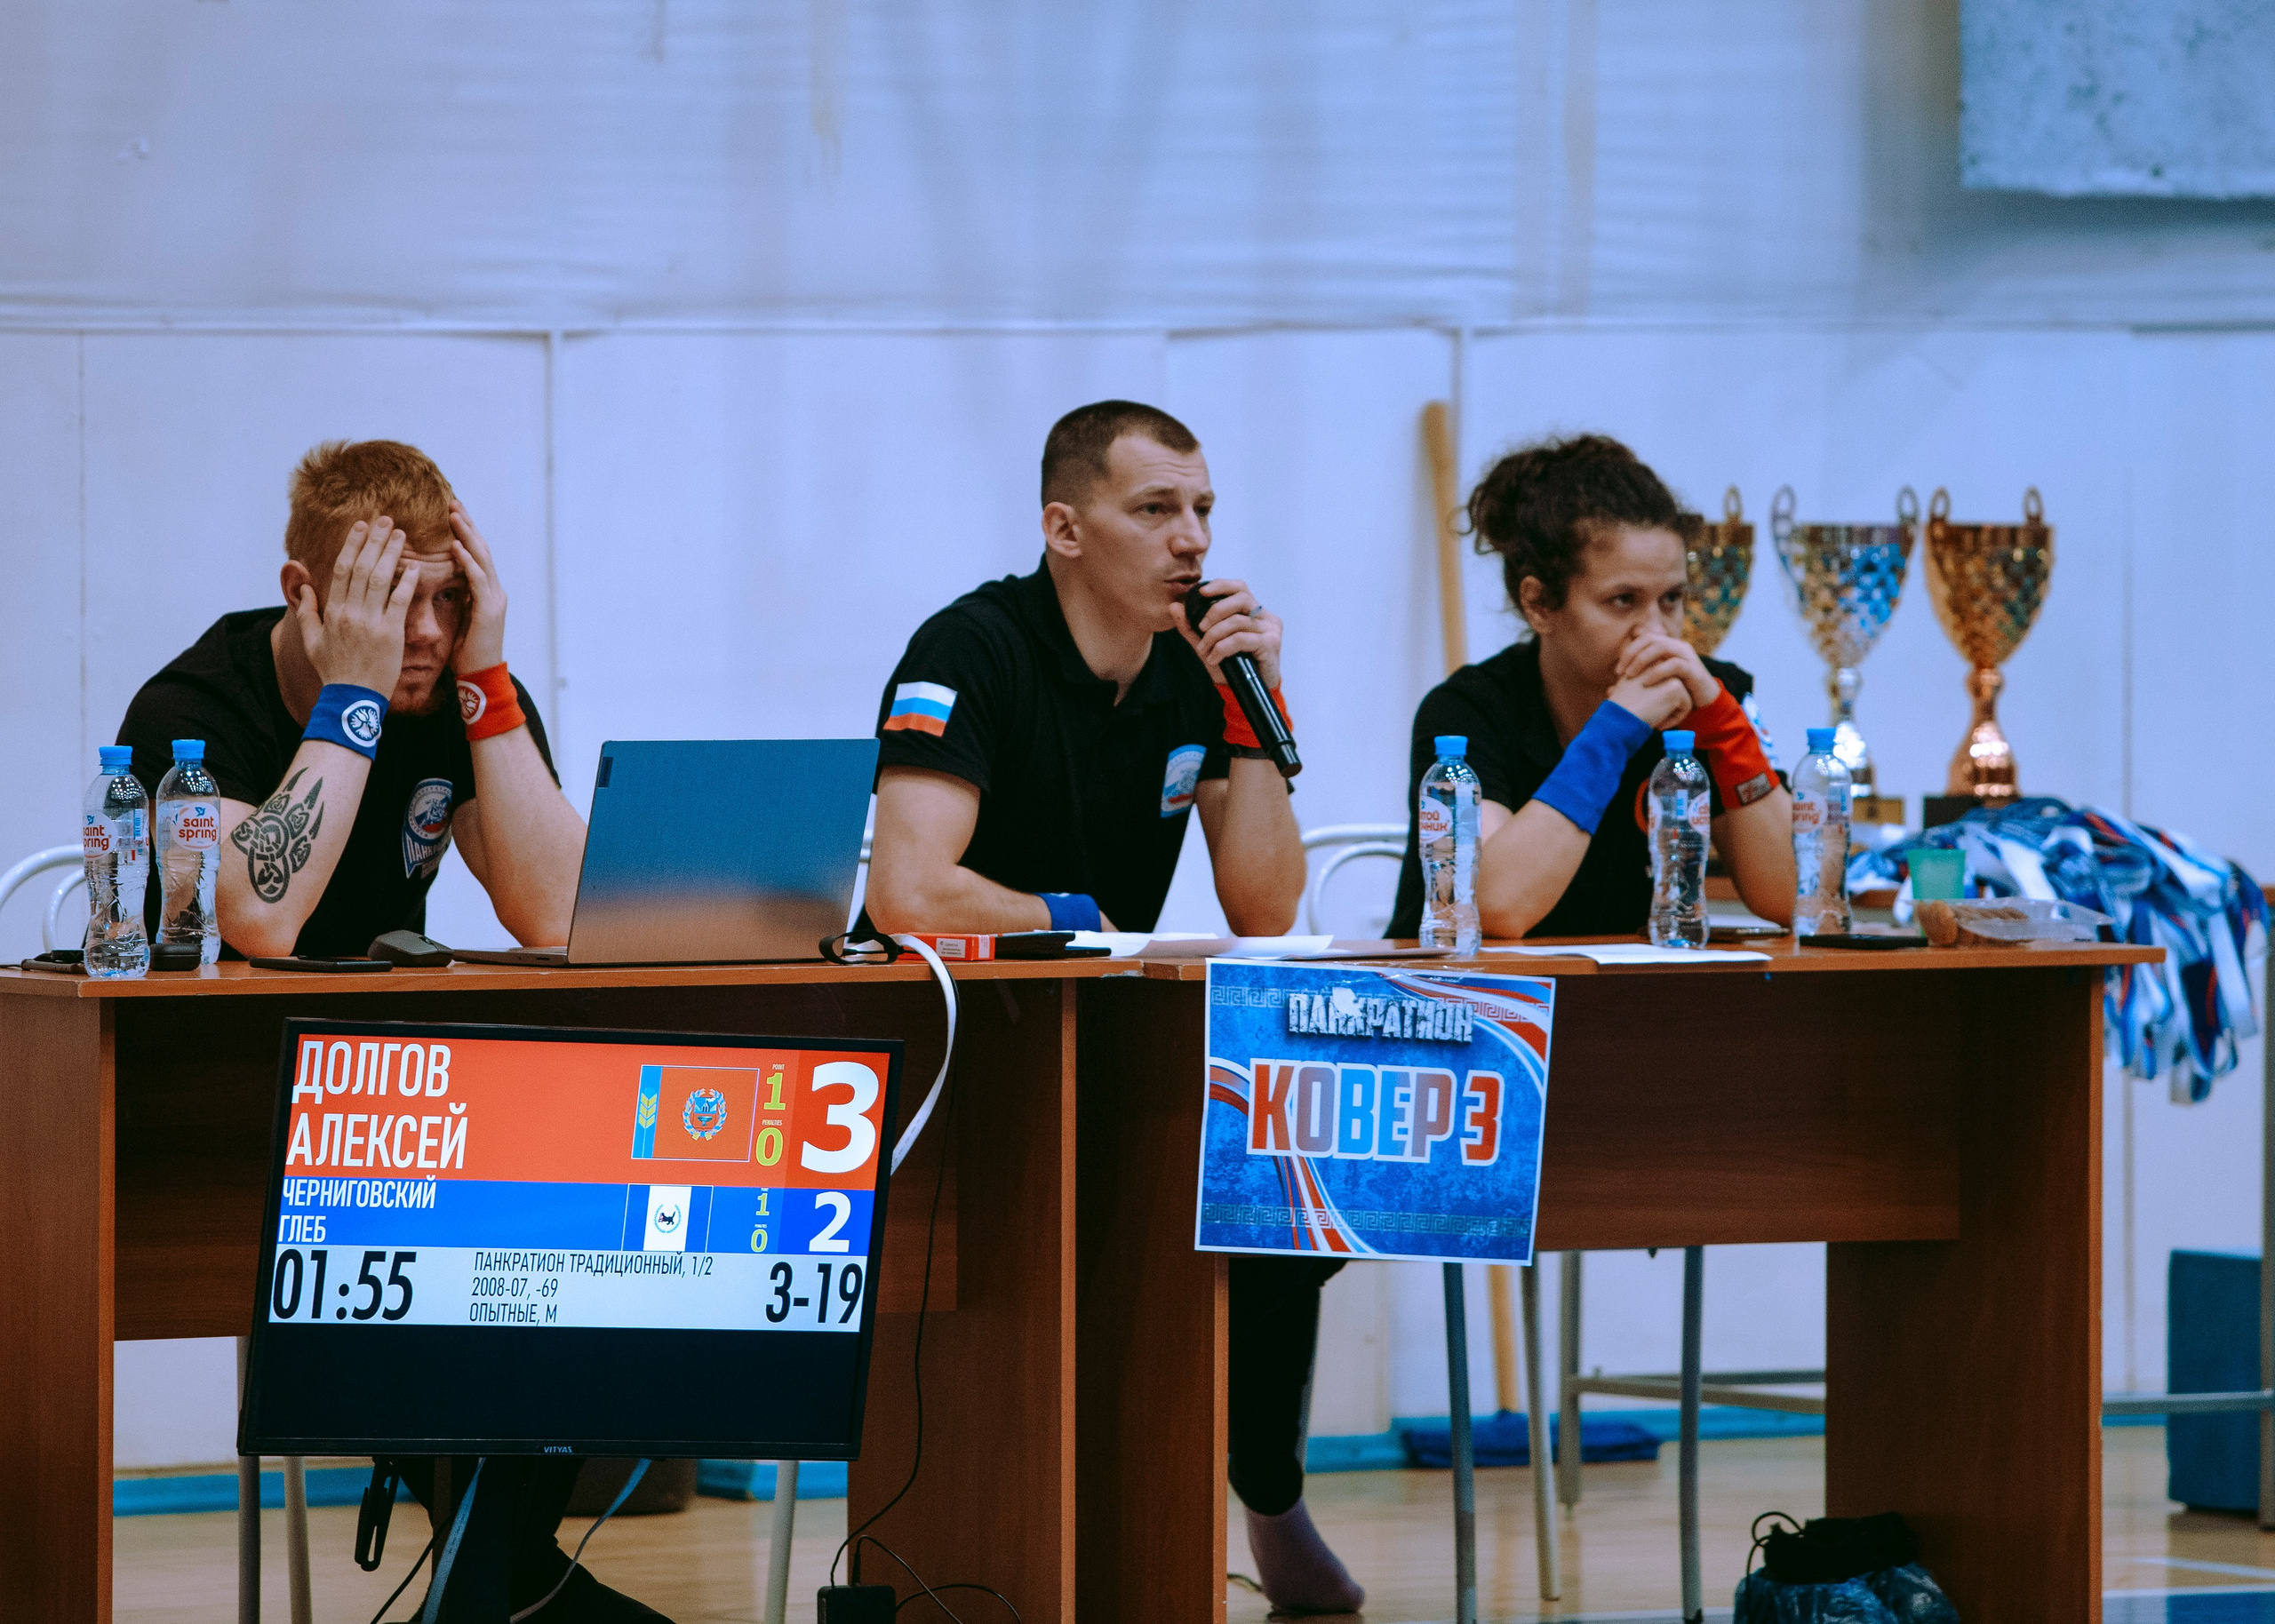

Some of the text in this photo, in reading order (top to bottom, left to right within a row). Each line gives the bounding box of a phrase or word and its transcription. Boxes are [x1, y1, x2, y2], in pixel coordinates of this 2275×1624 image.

[179, 828, 217, 842] spring
[183, 816, 214, 827] saint
[83, 837, 109, 851] pring
[291, 1040, 451, 1104] ДОЛГОВ
[763, 1071, 786, 1111] 1
[801, 1061, 880, 1174] 3
[1246, 1057, 1505, 1166] КОВЕР 3
[285, 1102, 468, 1169] АЛЕКСЕЙ
[755, 1126, 784, 1166] 0
[283, 1174, 436, 1209] ЧЕРНИГОВСКИЙ
[755, 1192, 770, 1216] 1
[277, 1214, 327, 1243] ГЛЕБ
[808, 1191, 851, 1253] 2
[750, 1229, 769, 1253] 0
[475, 1251, 714, 1278] ПАНКРАТИОН ТРАДИЦИОННЫЙ, 1/2
[272, 1248, 417, 1321] 01:55
[471, 1277, 559, 1300] 2008-07, -69
[765, 1261, 864, 1324] 3-19
[469, 1302, 558, 1326] ОПЫТНЫЕ, М
